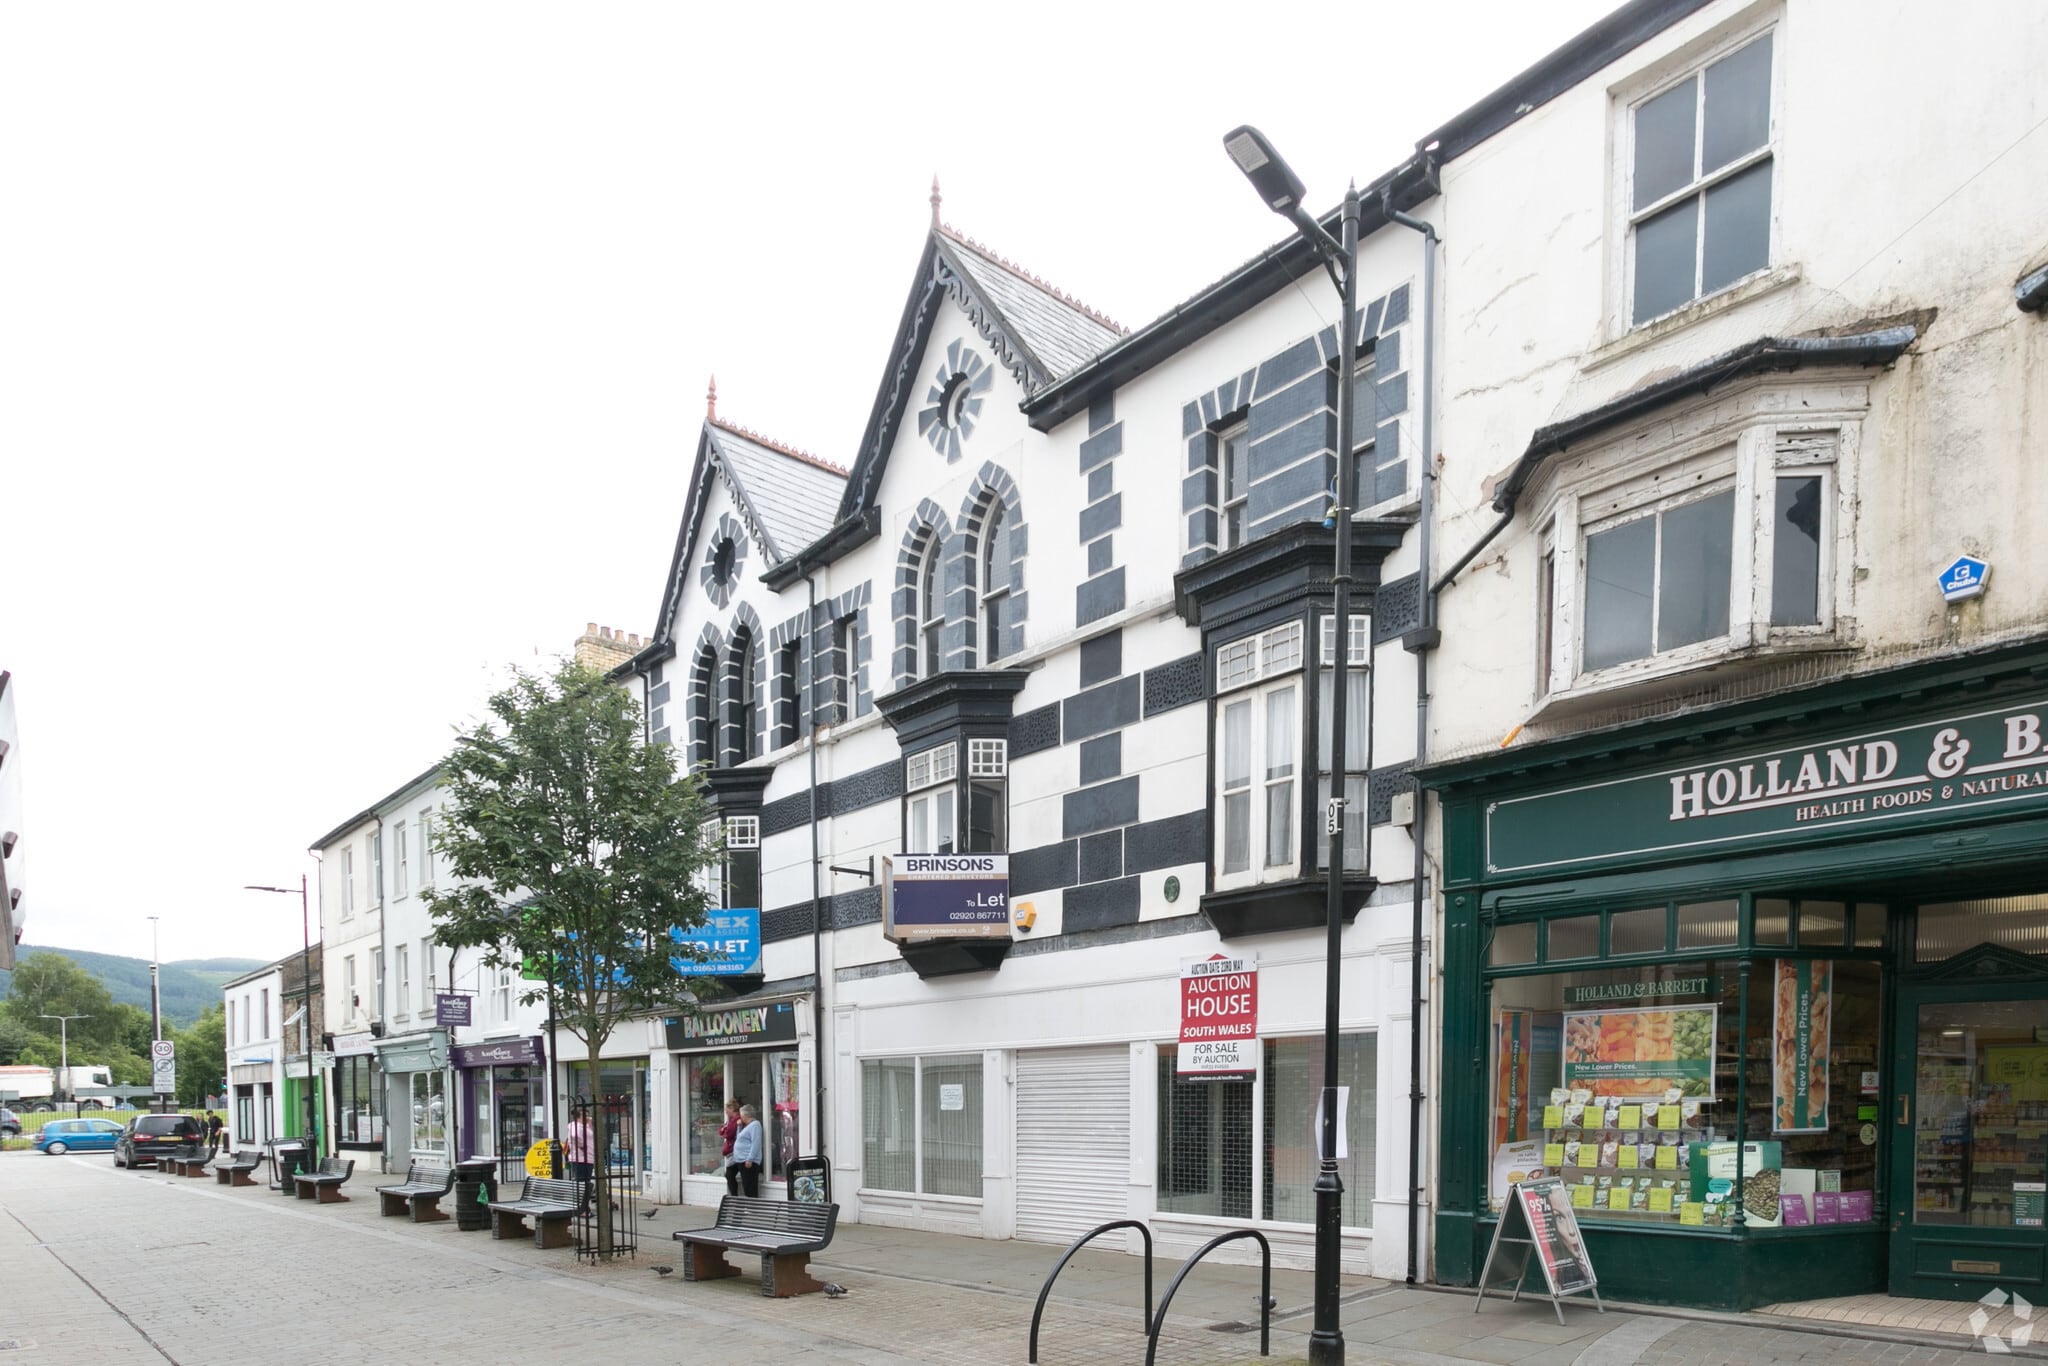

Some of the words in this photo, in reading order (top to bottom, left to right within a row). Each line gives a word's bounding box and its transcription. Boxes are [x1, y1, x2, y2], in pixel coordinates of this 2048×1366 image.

[1669, 740, 1898, 821] HOLLAND
[1927, 728, 1970, 778] &
[2003, 714, 2048, 758] B
[1796, 798, 1865, 821] HEALTH
[1872, 788, 1932, 810] FOODS
[1941, 786, 1953, 799] &
[1962, 771, 2048, 797] NATURA
[907, 858, 994, 871] BRINSONS
[978, 892, 1004, 906] Let
[714, 940, 749, 952] LET
[1192, 963, 1208, 975] AUCTION
[1209, 962, 1220, 973] DATE
[1233, 960, 1243, 971] MAY
[1188, 974, 1250, 994] AUCTION
[1576, 984, 1631, 1001] HOLLAND
[1633, 983, 1645, 997] &
[1650, 978, 1708, 995] BARRETT
[1188, 994, 1250, 1018] HOUSE
[1799, 990, 1808, 1029] Prices.
[684, 1007, 768, 1039] BALLOONERY
[1184, 1026, 1216, 1038] SOUTH
[1218, 1023, 1252, 1035] WALES
[1195, 1044, 1212, 1054] FOR
[1215, 1042, 1237, 1053] SALE
[1799, 1032, 1807, 1066] Lower
[1204, 1054, 1239, 1063] AUCTION
[1798, 1074, 1808, 1096] New
[1529, 1197, 1550, 1212] 95%
